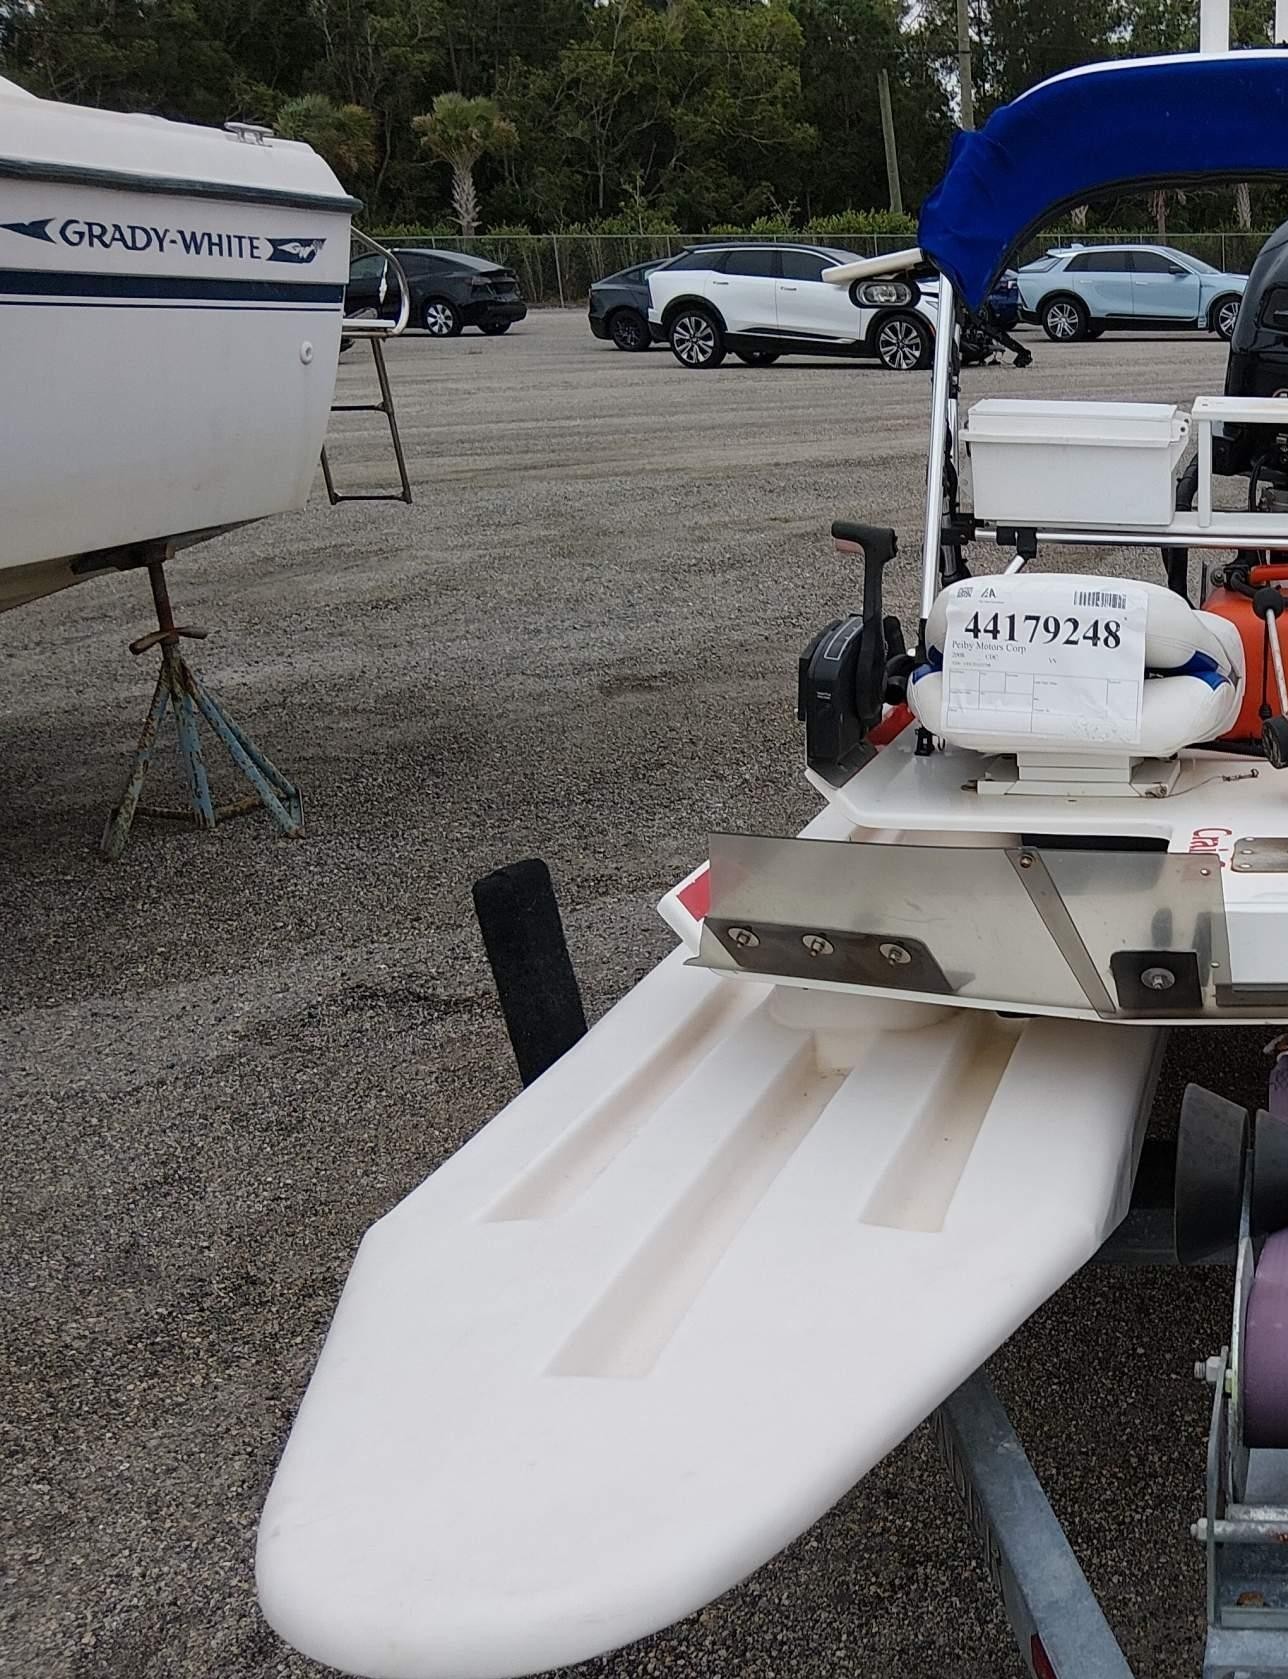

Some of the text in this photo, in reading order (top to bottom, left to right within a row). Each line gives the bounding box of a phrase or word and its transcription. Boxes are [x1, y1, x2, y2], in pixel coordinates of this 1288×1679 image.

[59, 219, 263, 259] GRADY-WHITE
[964, 611, 1121, 649] 44179248
[976, 641, 1003, 651] Motors
[1006, 643, 1027, 655] Corp
[1189, 827, 1232, 866] Crai
